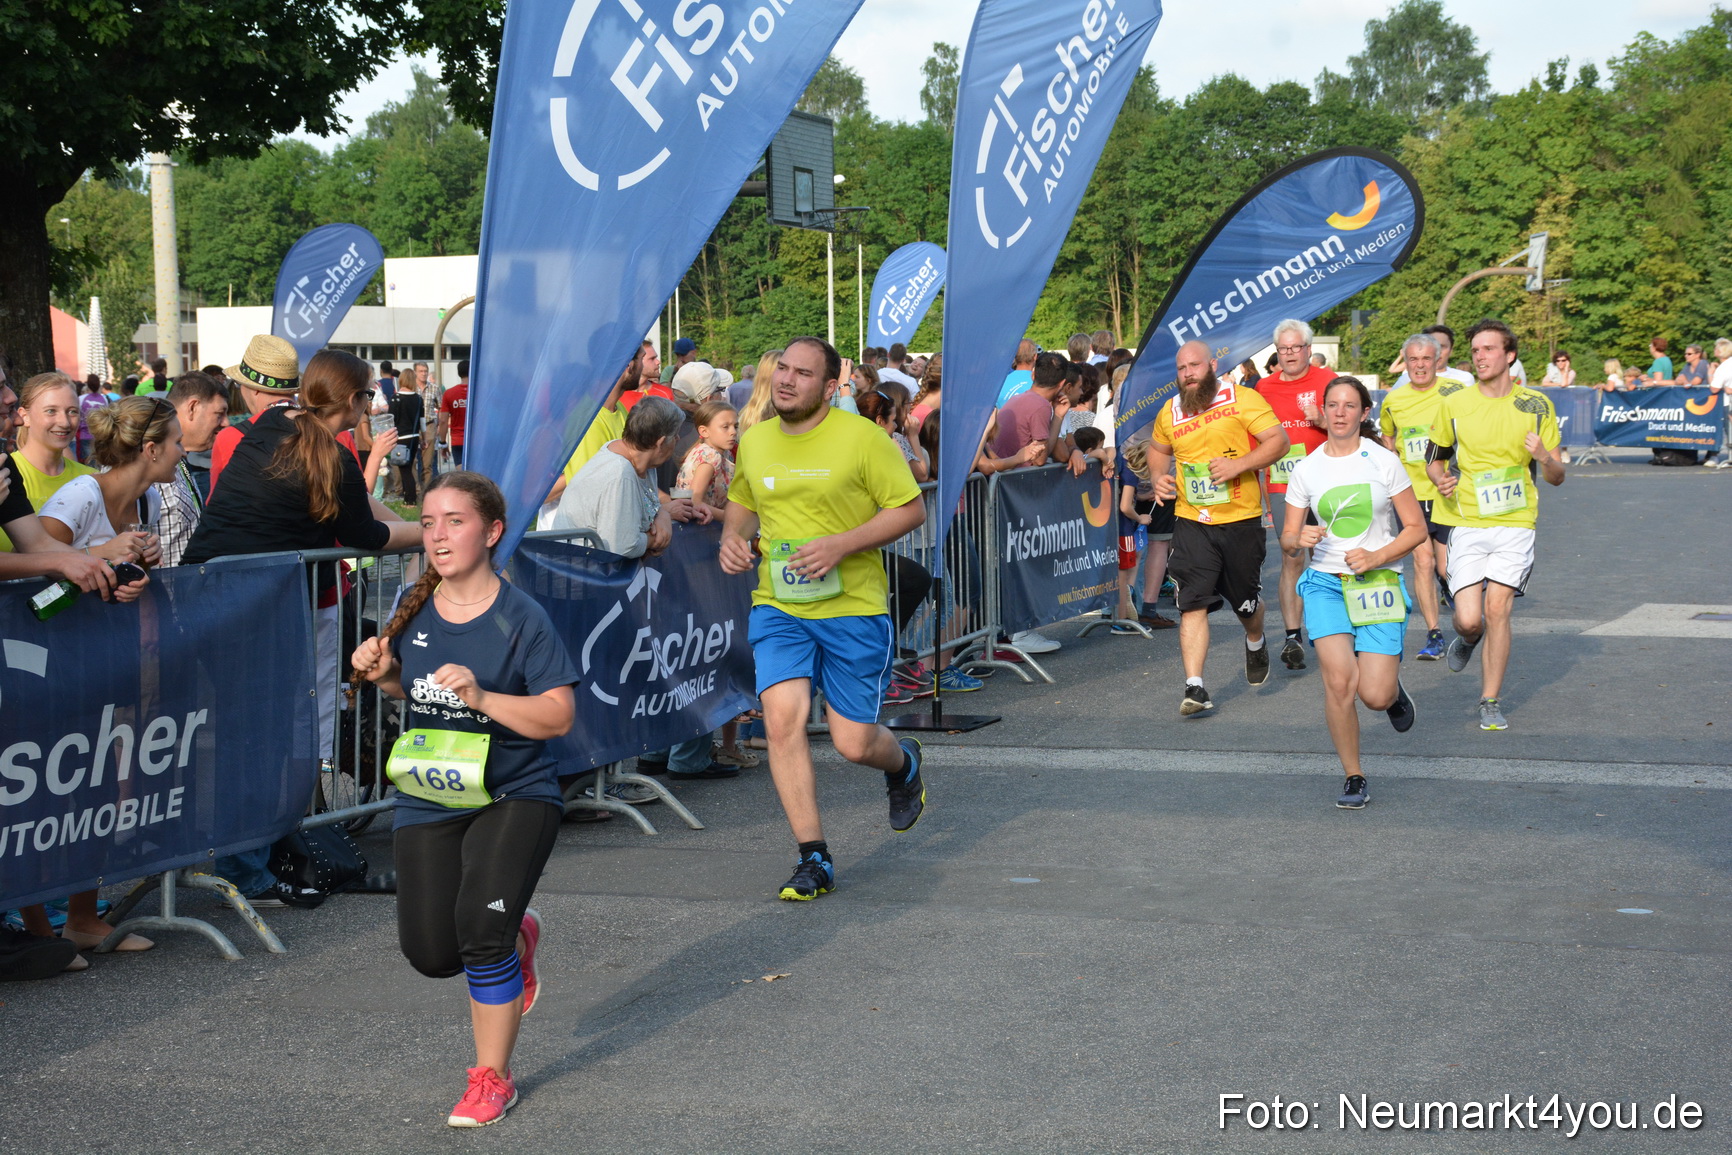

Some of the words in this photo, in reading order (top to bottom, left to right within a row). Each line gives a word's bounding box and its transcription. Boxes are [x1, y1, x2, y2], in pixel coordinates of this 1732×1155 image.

[1003, 0, 1117, 207] Fische
[1043, 12, 1129, 204] AUTOMOBILE
[298, 242, 359, 325] Fischer
[1282, 263, 1326, 299] Druck
[1328, 253, 1355, 274] und
[1355, 222, 1406, 260] Medien
[320, 258, 367, 324] AUTOMOBILE
[888, 257, 933, 324] Fischer
[905, 269, 939, 323] AUTOMOBILE
[1168, 234, 1345, 346] Frischmann
[1173, 420, 1201, 440] MAX
[1204, 406, 1240, 425] BÖGL
[1600, 405, 1684, 423] Frischmann
[1648, 421, 1666, 430] Druck
[1667, 422, 1684, 431] und
[1685, 423, 1717, 433] Medien
[1191, 479, 1219, 494] 914
[1482, 483, 1522, 503] 1174
[1006, 515, 1086, 563] Frischmann
[1054, 555, 1074, 577] Druck
[1074, 551, 1092, 571] und
[1092, 546, 1118, 567] Medien
[1357, 590, 1394, 610] 110
[631, 669, 717, 719] AUTOMOBILE
[408, 766, 466, 791] 168
